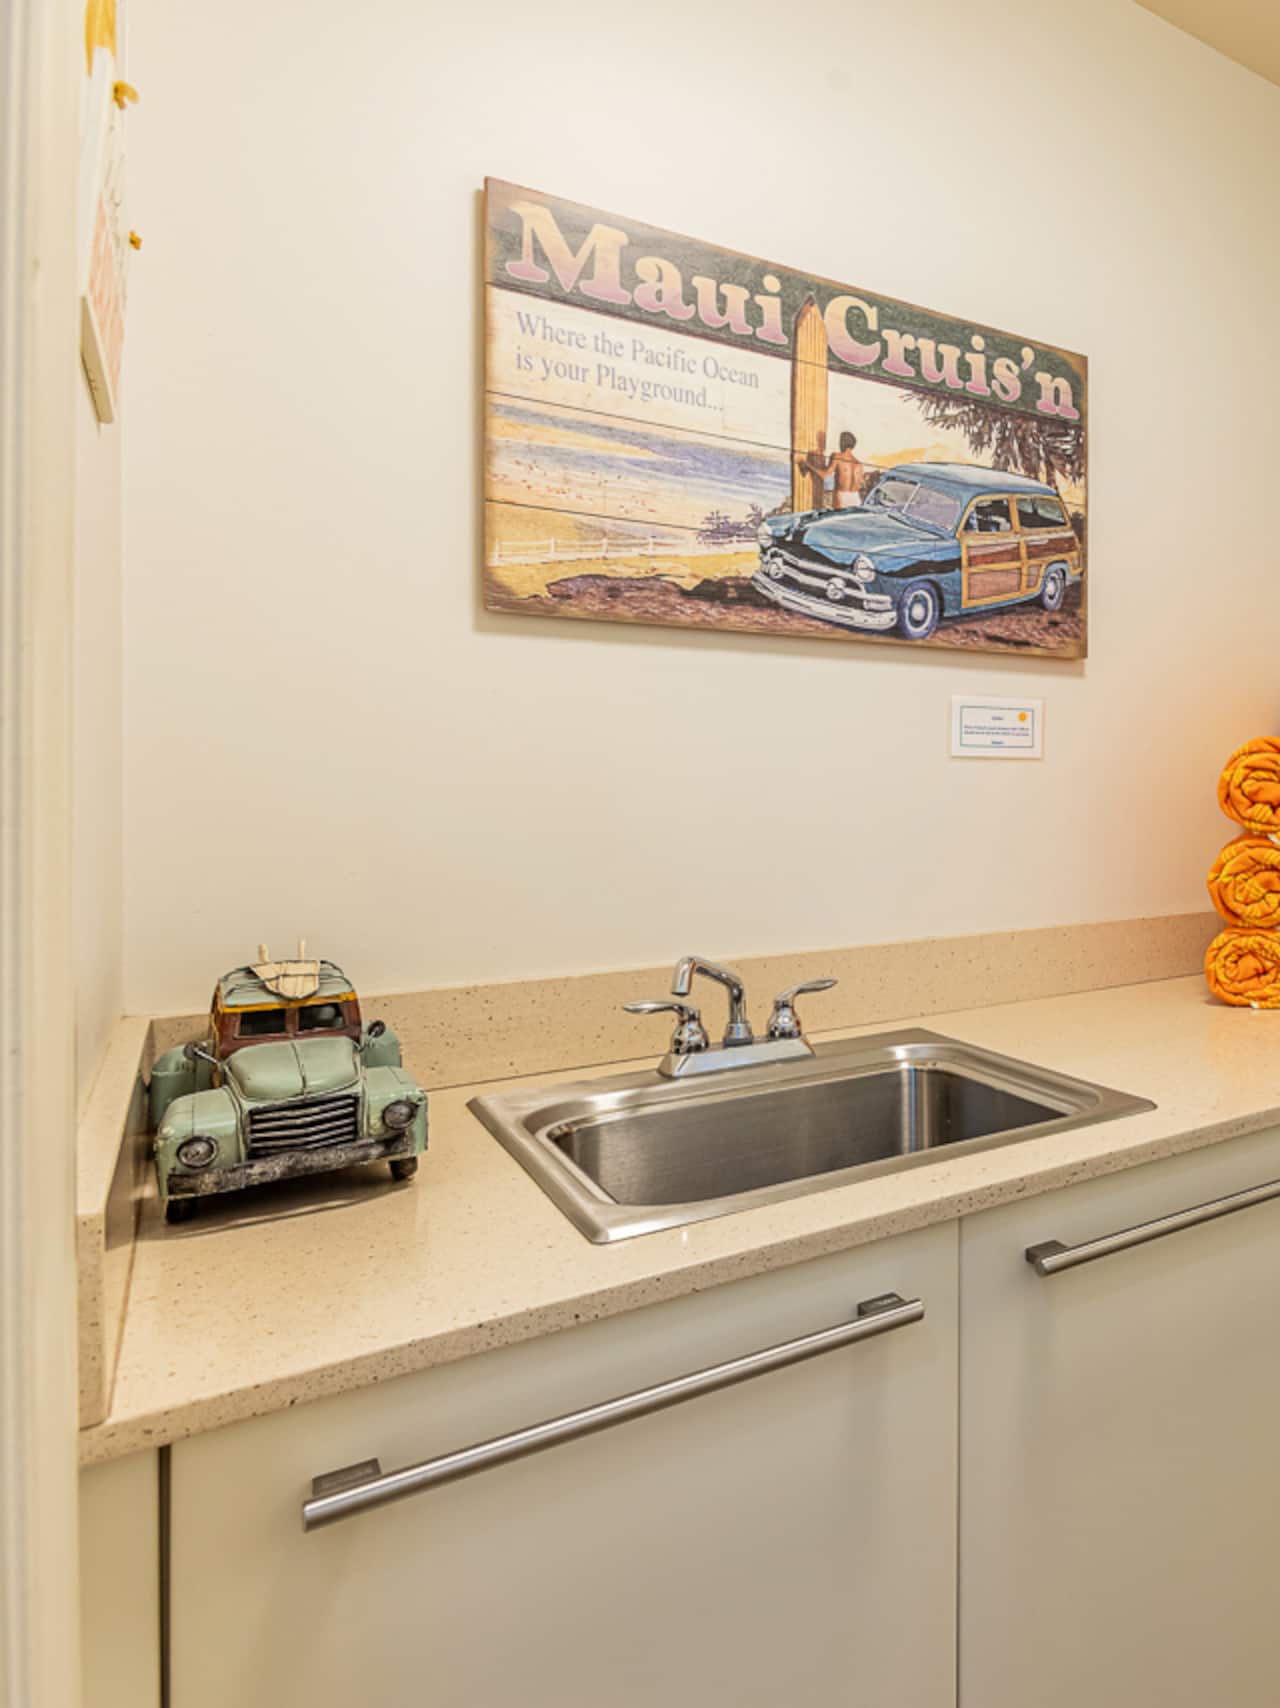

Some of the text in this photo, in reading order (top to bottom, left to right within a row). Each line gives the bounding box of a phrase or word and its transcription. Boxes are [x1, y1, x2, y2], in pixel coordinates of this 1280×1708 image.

[506, 200, 1081, 420] Maui Cruis'n
[516, 311, 760, 390] Where the Pacific Ocean
[516, 346, 724, 412] is your Playground...
